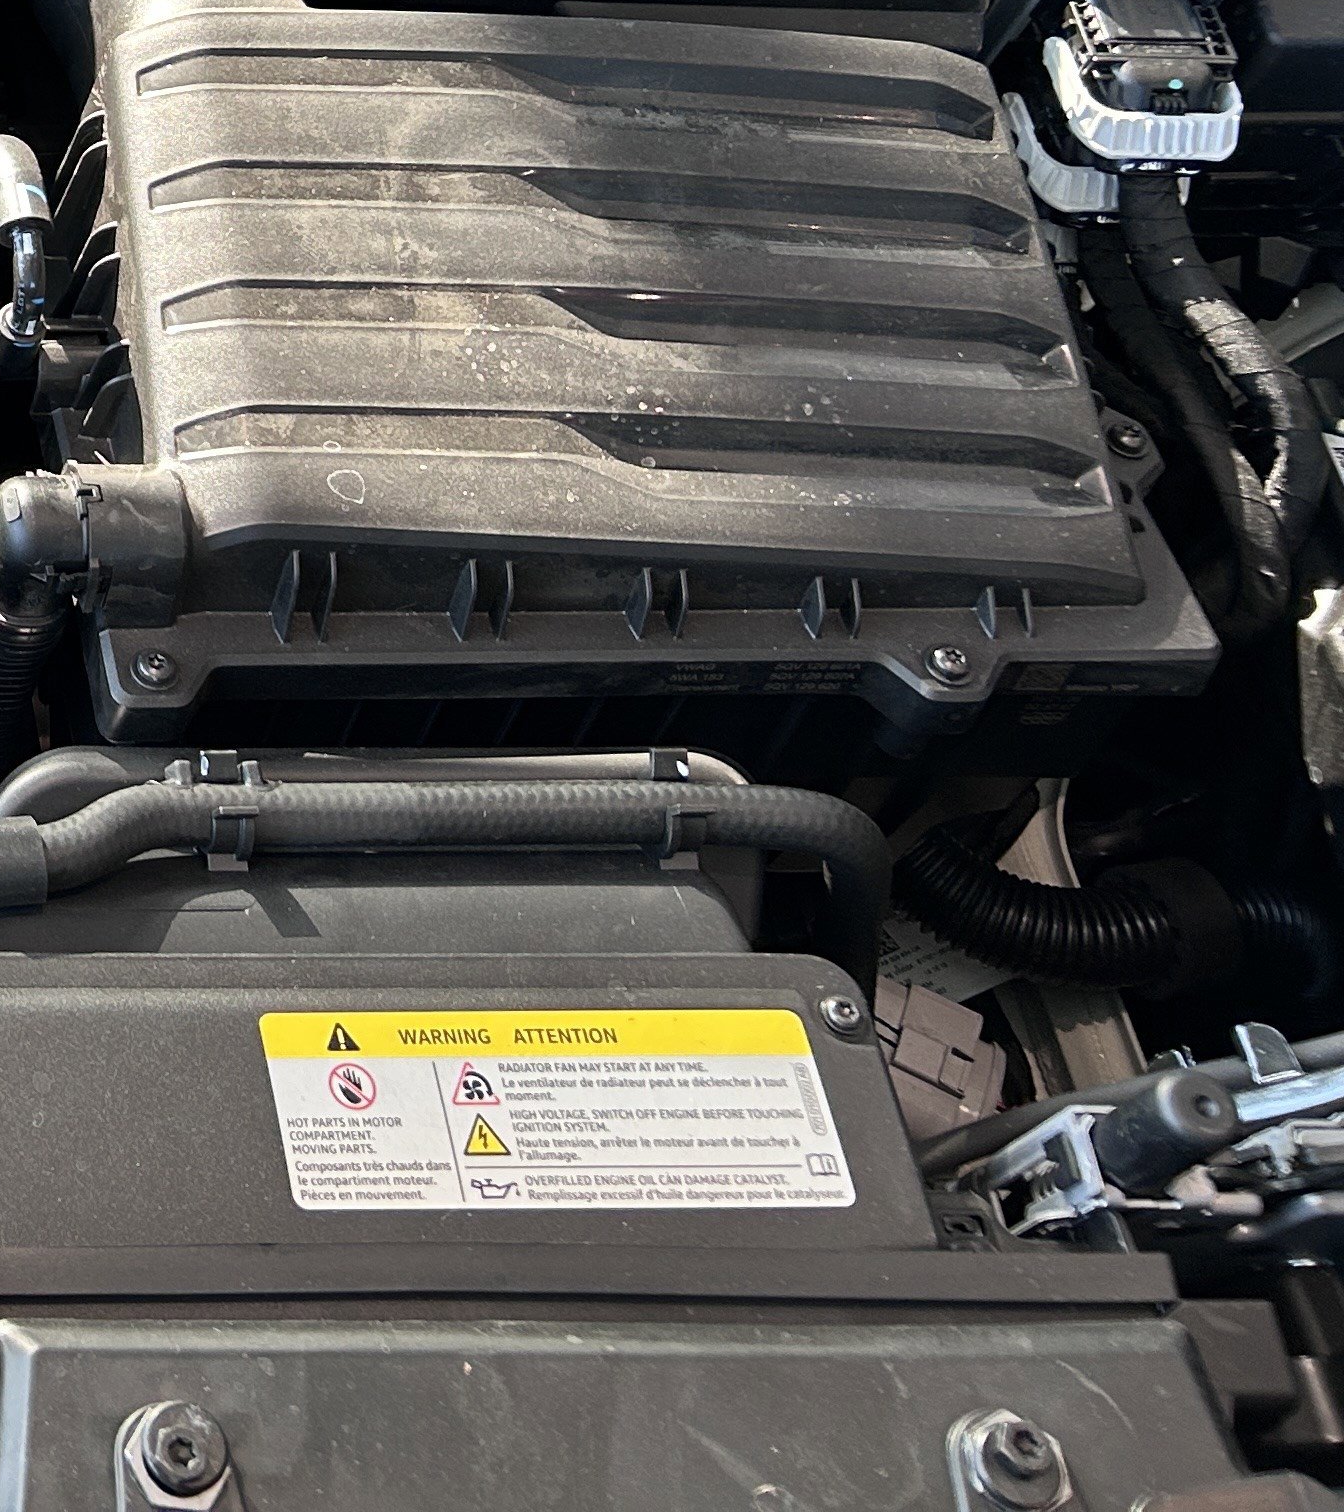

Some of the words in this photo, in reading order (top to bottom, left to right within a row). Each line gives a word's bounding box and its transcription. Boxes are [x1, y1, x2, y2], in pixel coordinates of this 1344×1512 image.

[397, 1028, 491, 1045] WARNING
[514, 1028, 618, 1044] ATTENTION
[498, 1063, 552, 1072] RADIATOR
[554, 1063, 576, 1072] FAN
[579, 1063, 602, 1072] MAY
[604, 1063, 637, 1072] START
[639, 1062, 653, 1071] AT
[655, 1062, 675, 1071] ANY
[501, 1078, 514, 1088] Le
[517, 1078, 577, 1088] ventilateur
[579, 1078, 593, 1088] de
[595, 1078, 647, 1087] radiateur
[649, 1077, 674, 1088] peut
[677, 1079, 690, 1087] se
[692, 1076, 751, 1087] déclencher
[754, 1076, 761, 1087] à
[763, 1077, 788, 1087] tout
[505, 1092, 556, 1101] moment.
[509, 1110, 537, 1120] HIGH
[592, 1109, 634, 1119] SWITCH
[636, 1109, 657, 1119] OFF
[659, 1109, 701, 1119] ENGINE
[702, 1109, 745, 1119] BEFORE
[748, 1109, 804, 1119] TOUCHING
[287, 1118, 309, 1127] HOT
[312, 1118, 346, 1127] PARTS
[348, 1118, 360, 1127] IN
[363, 1117, 402, 1127] MOTOR
[512, 1122, 562, 1132] IGNITION
[564, 1122, 609, 1132] SYSTEM.
[289, 1130, 376, 1141] COMPARTMENT.
[516, 1138, 550, 1148] Haute
[640, 1137, 651, 1148] le
[654, 1137, 694, 1147] moteur
[731, 1136, 745, 1147] de
[747, 1136, 789, 1147] toucher
[292, 1144, 337, 1155] MOVING
[340, 1144, 377, 1154] PARTS.
[295, 1160, 362, 1173] Composants
[363, 1160, 384, 1171] très
[386, 1160, 424, 1171] chauds
[426, 1160, 452, 1171] dans
[297, 1175, 309, 1186] le
[310, 1175, 390, 1187] compartiment
[394, 1176, 437, 1185] moteur.
[525, 1174, 592, 1186] OVERFILLED
[594, 1174, 636, 1186] ENGINE
[638, 1174, 656, 1185] OIL
[658, 1174, 682, 1185] CAN
[684, 1174, 731, 1185] DAMAGE
[734, 1174, 789, 1185] CATALYST.
[300, 1190, 336, 1201] Pièces
[339, 1192, 352, 1200] en
[355, 1190, 427, 1200] mouvement.
[528, 1190, 598, 1202] Remplissage
[600, 1189, 643, 1200] excessif
[646, 1189, 684, 1200] d'huile
[685, 1190, 745, 1202] dangereux
[747, 1190, 772, 1201] pour
[774, 1188, 785, 1199] le
